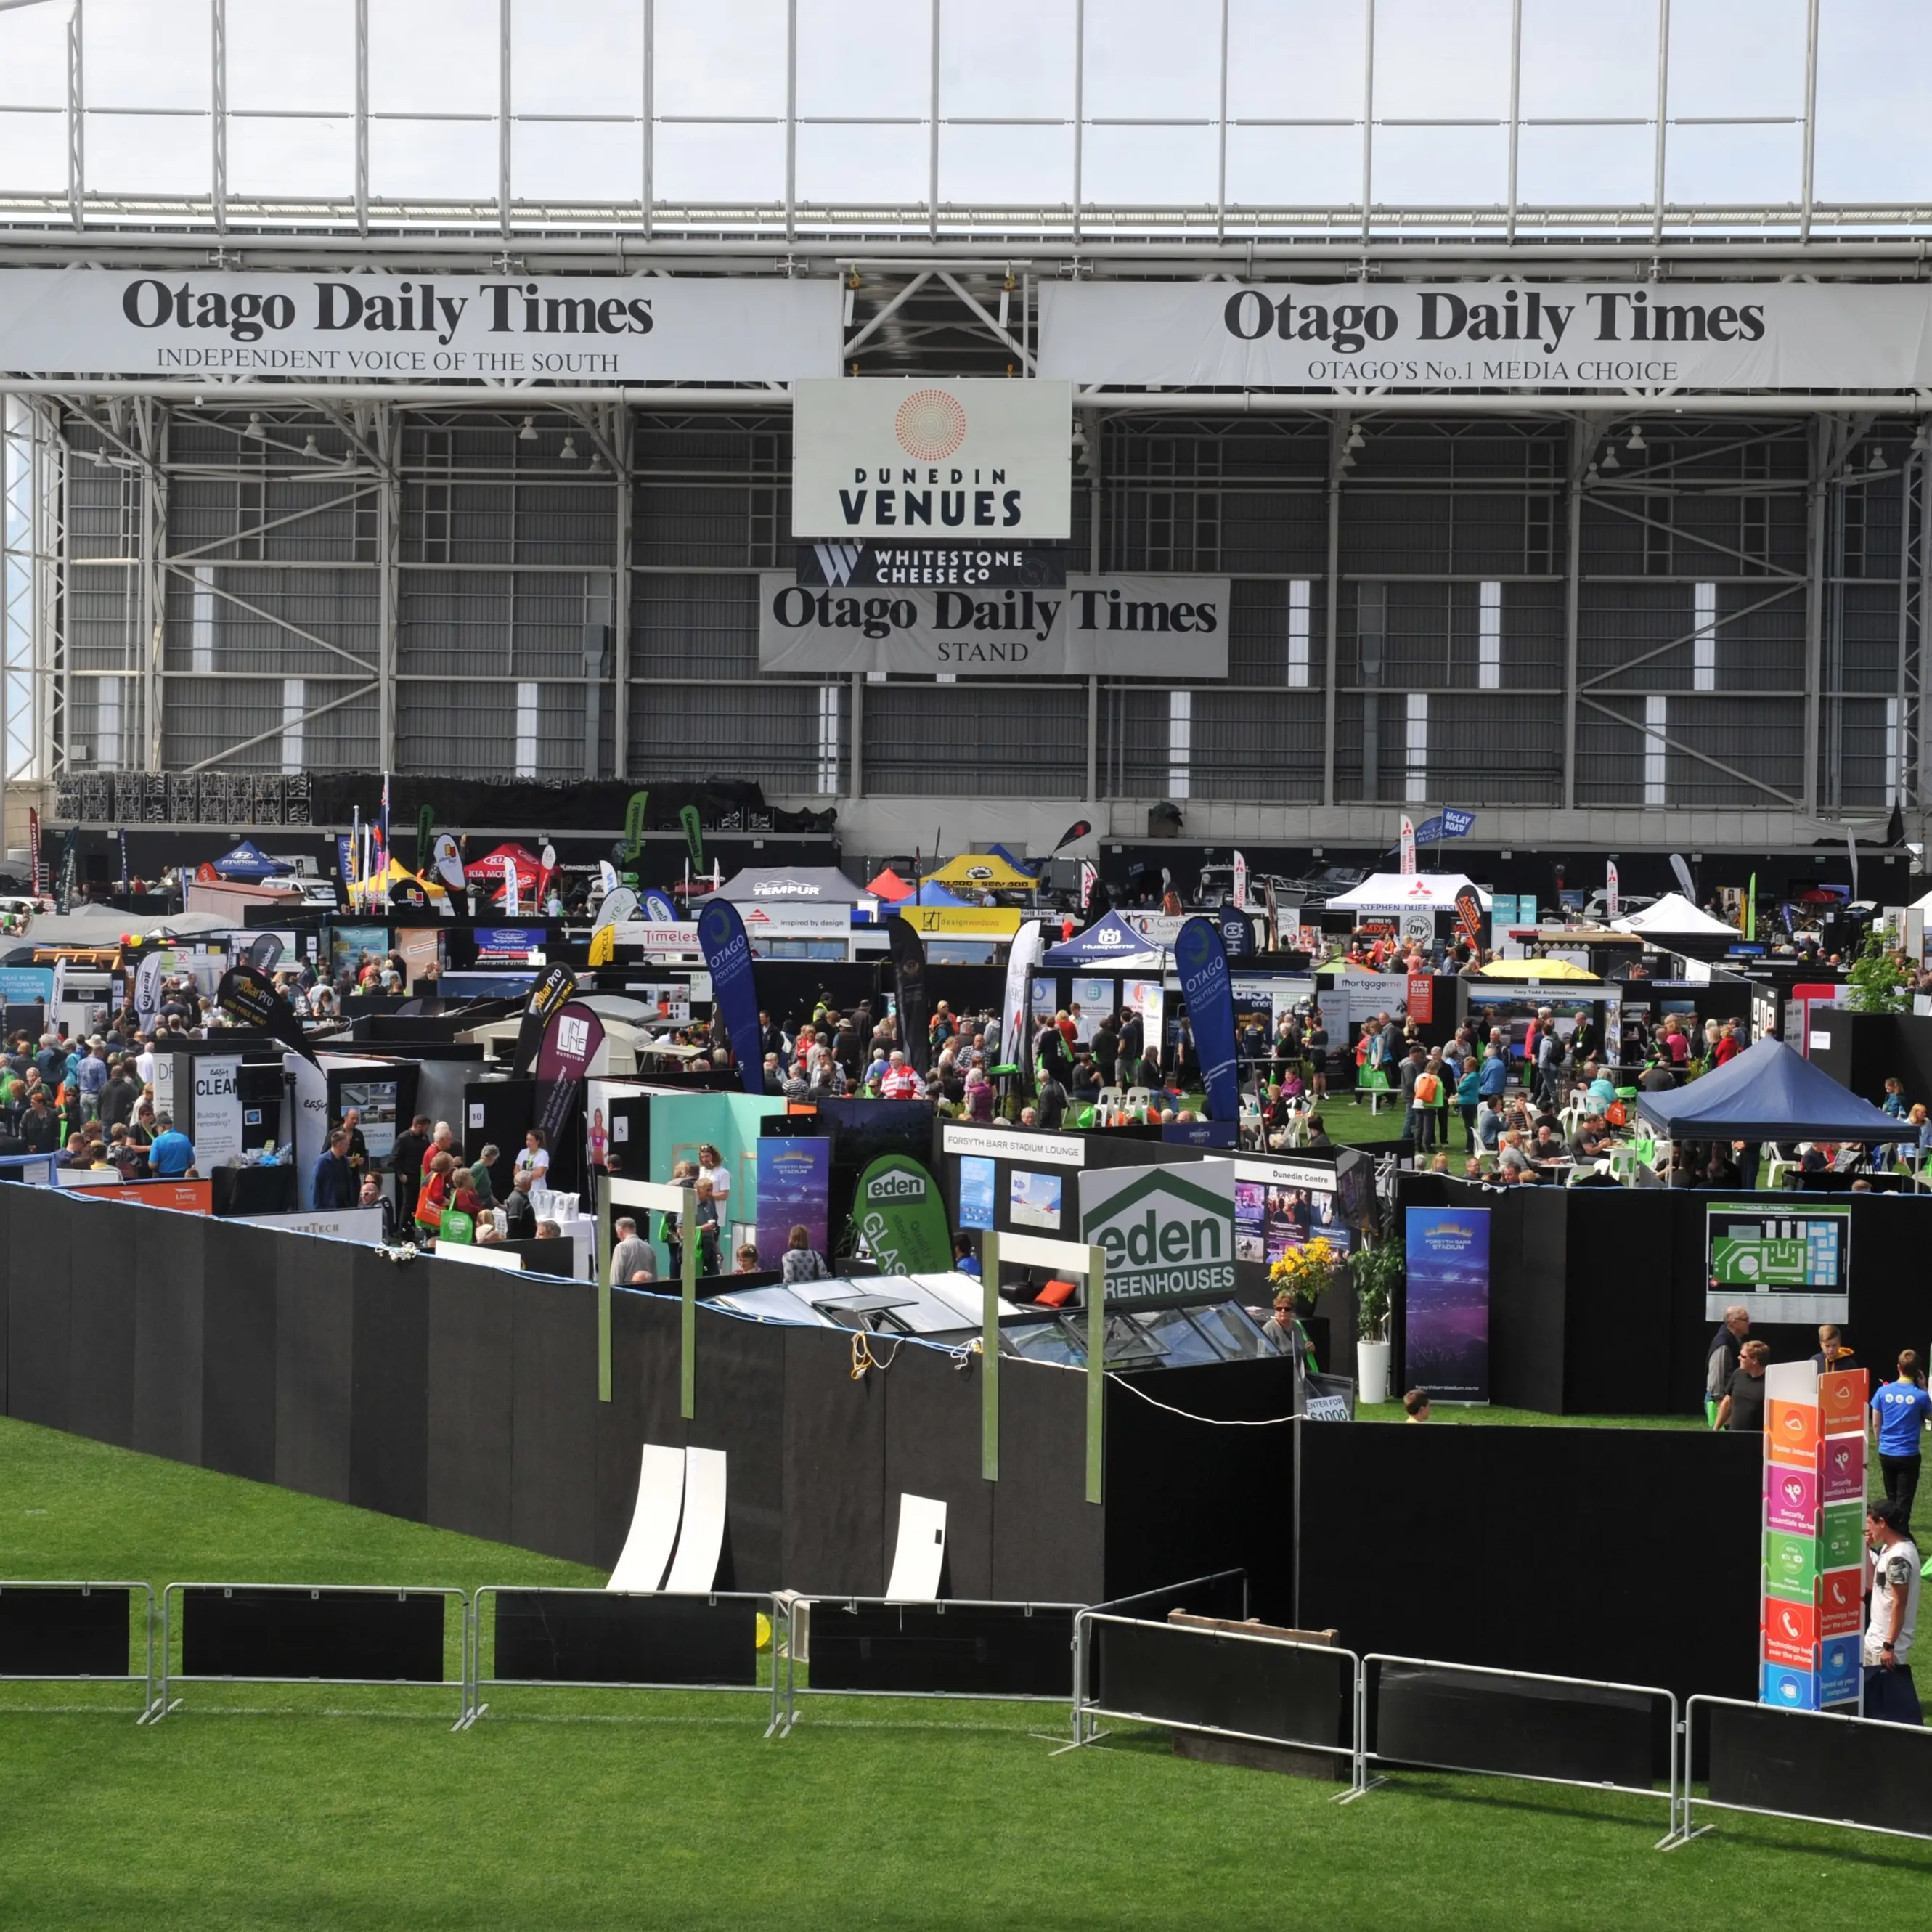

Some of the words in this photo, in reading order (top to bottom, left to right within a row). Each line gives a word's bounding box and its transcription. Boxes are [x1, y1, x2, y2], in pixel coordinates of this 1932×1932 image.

[122, 279, 295, 341] Otago
[314, 282, 469, 346] Daily
[479, 283, 654, 336] Times
[1224, 290, 1398, 354] Otago
[1416, 290, 1575, 354] Daily
[1586, 290, 1765, 341] Times
[157, 348, 340, 370] INDEPENDENT
[349, 349, 427, 370] VOICE
[434, 351, 466, 372] OF
[468, 352, 524, 372] THE
[531, 353, 620, 372] SOUTH
[1308, 361, 1418, 380] OTAGO'S
[1425, 361, 1473, 380] No.1
[1483, 362, 1570, 380] MEDIA
[1577, 362, 1678, 381] CHOICE
[855, 468, 1005, 484] DUNEDIN
[839, 489, 1022, 526] VENUES
[875, 550, 1022, 566] WHITESTONE
[876, 568, 958, 584] CHEESE
[772, 587, 918, 639] Otago
[932, 589, 1061, 642] Daily
[1070, 589, 1218, 634] Times
[938, 643, 1029, 662] STAND
[629, 802, 640, 853] Kawasaki
[685, 813, 701, 859] Kawasaki
[753, 885, 819, 895] TEMPUR
[649, 898, 667, 921] ChemD
[643, 930, 697, 943] Timeles
[1410, 925, 1425, 934] DIY
[260, 945, 275, 969] Hooker
[711, 935, 745, 969] OTAGO
[715, 950, 749, 981] POLYTECHNIC
[1186, 956, 1223, 992] OTAGO
[238, 980, 273, 1006] SolarPro
[535, 969, 562, 1008] SolarPro
[1191, 978, 1226, 1006] POLYTECHNIC
[556, 1051, 584, 1061] NUTRITION
[210, 1068, 229, 1077] easy
[303, 1100, 327, 1113] easy
[197, 1119, 231, 1128] renovating?
[948, 1136, 984, 1146] FORSYTH
[1010, 1142, 1043, 1152] STADIUM
[1046, 1146, 1079, 1157] LOUNGE
[871, 1176, 921, 1197] eden
[1273, 1170, 1303, 1181] Dunedin
[1304, 1175, 1328, 1183] Centre
[863, 1212, 908, 1276] GLAS
[1095, 1210, 1220, 1269] eden
[1104, 1266, 1234, 1300] REENHOUSES
[1769, 1517, 1797, 1526] essentials
[1780, 1509, 1805, 1521] Security
[1822, 1613, 1847, 1622] echnology
[1767, 1638, 1800, 1653] Technology
